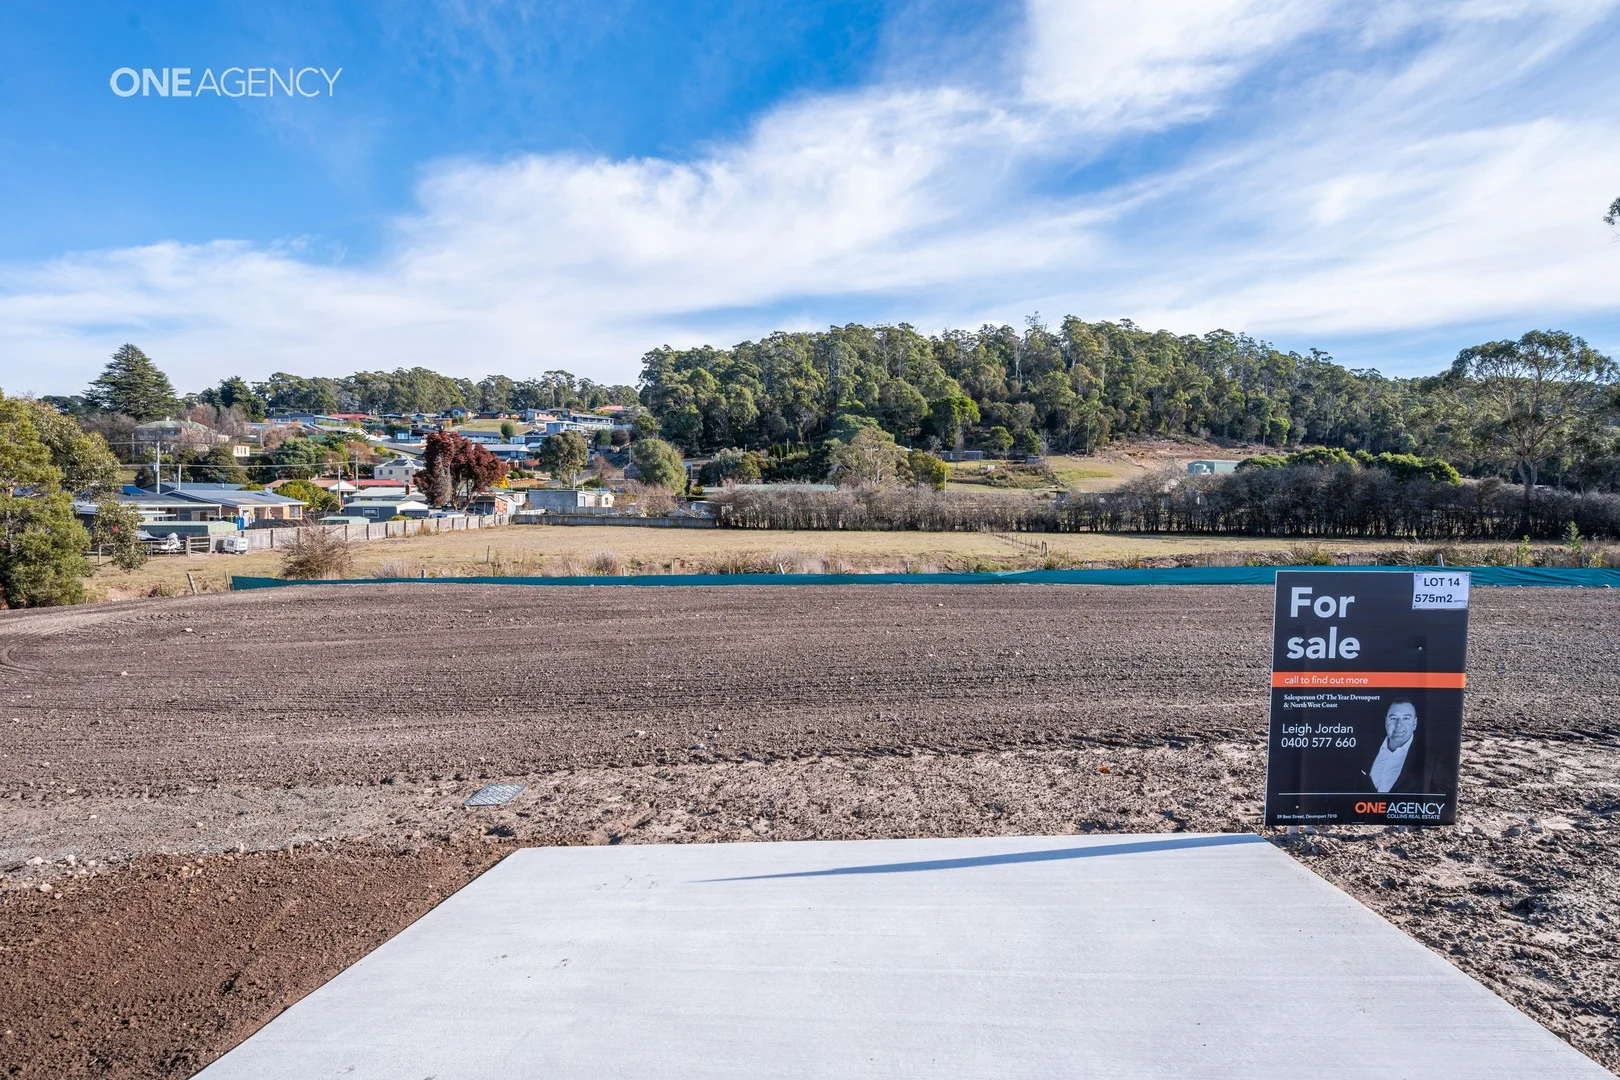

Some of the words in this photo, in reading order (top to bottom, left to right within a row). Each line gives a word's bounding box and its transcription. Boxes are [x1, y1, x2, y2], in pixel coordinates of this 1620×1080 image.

[1424, 577, 1445, 587] LOT
[1448, 577, 1460, 587] 14
[1290, 586, 1355, 618] For
[1415, 593, 1453, 603] 575m2
[1286, 626, 1360, 659] sale
[1284, 675, 1299, 684] call
[1301, 676, 1310, 684] to
[1312, 675, 1328, 684] find
[1329, 676, 1344, 684] out
[1283, 694, 1316, 702] Salesperson
[1350, 694, 1380, 702] Devonport
[1282, 723, 1312, 736] Leigh
[1315, 723, 1354, 734] Jordan
[1281, 737, 1309, 748] 0400
[1311, 737, 1332, 748] 577
[1335, 737, 1356, 748] 660
